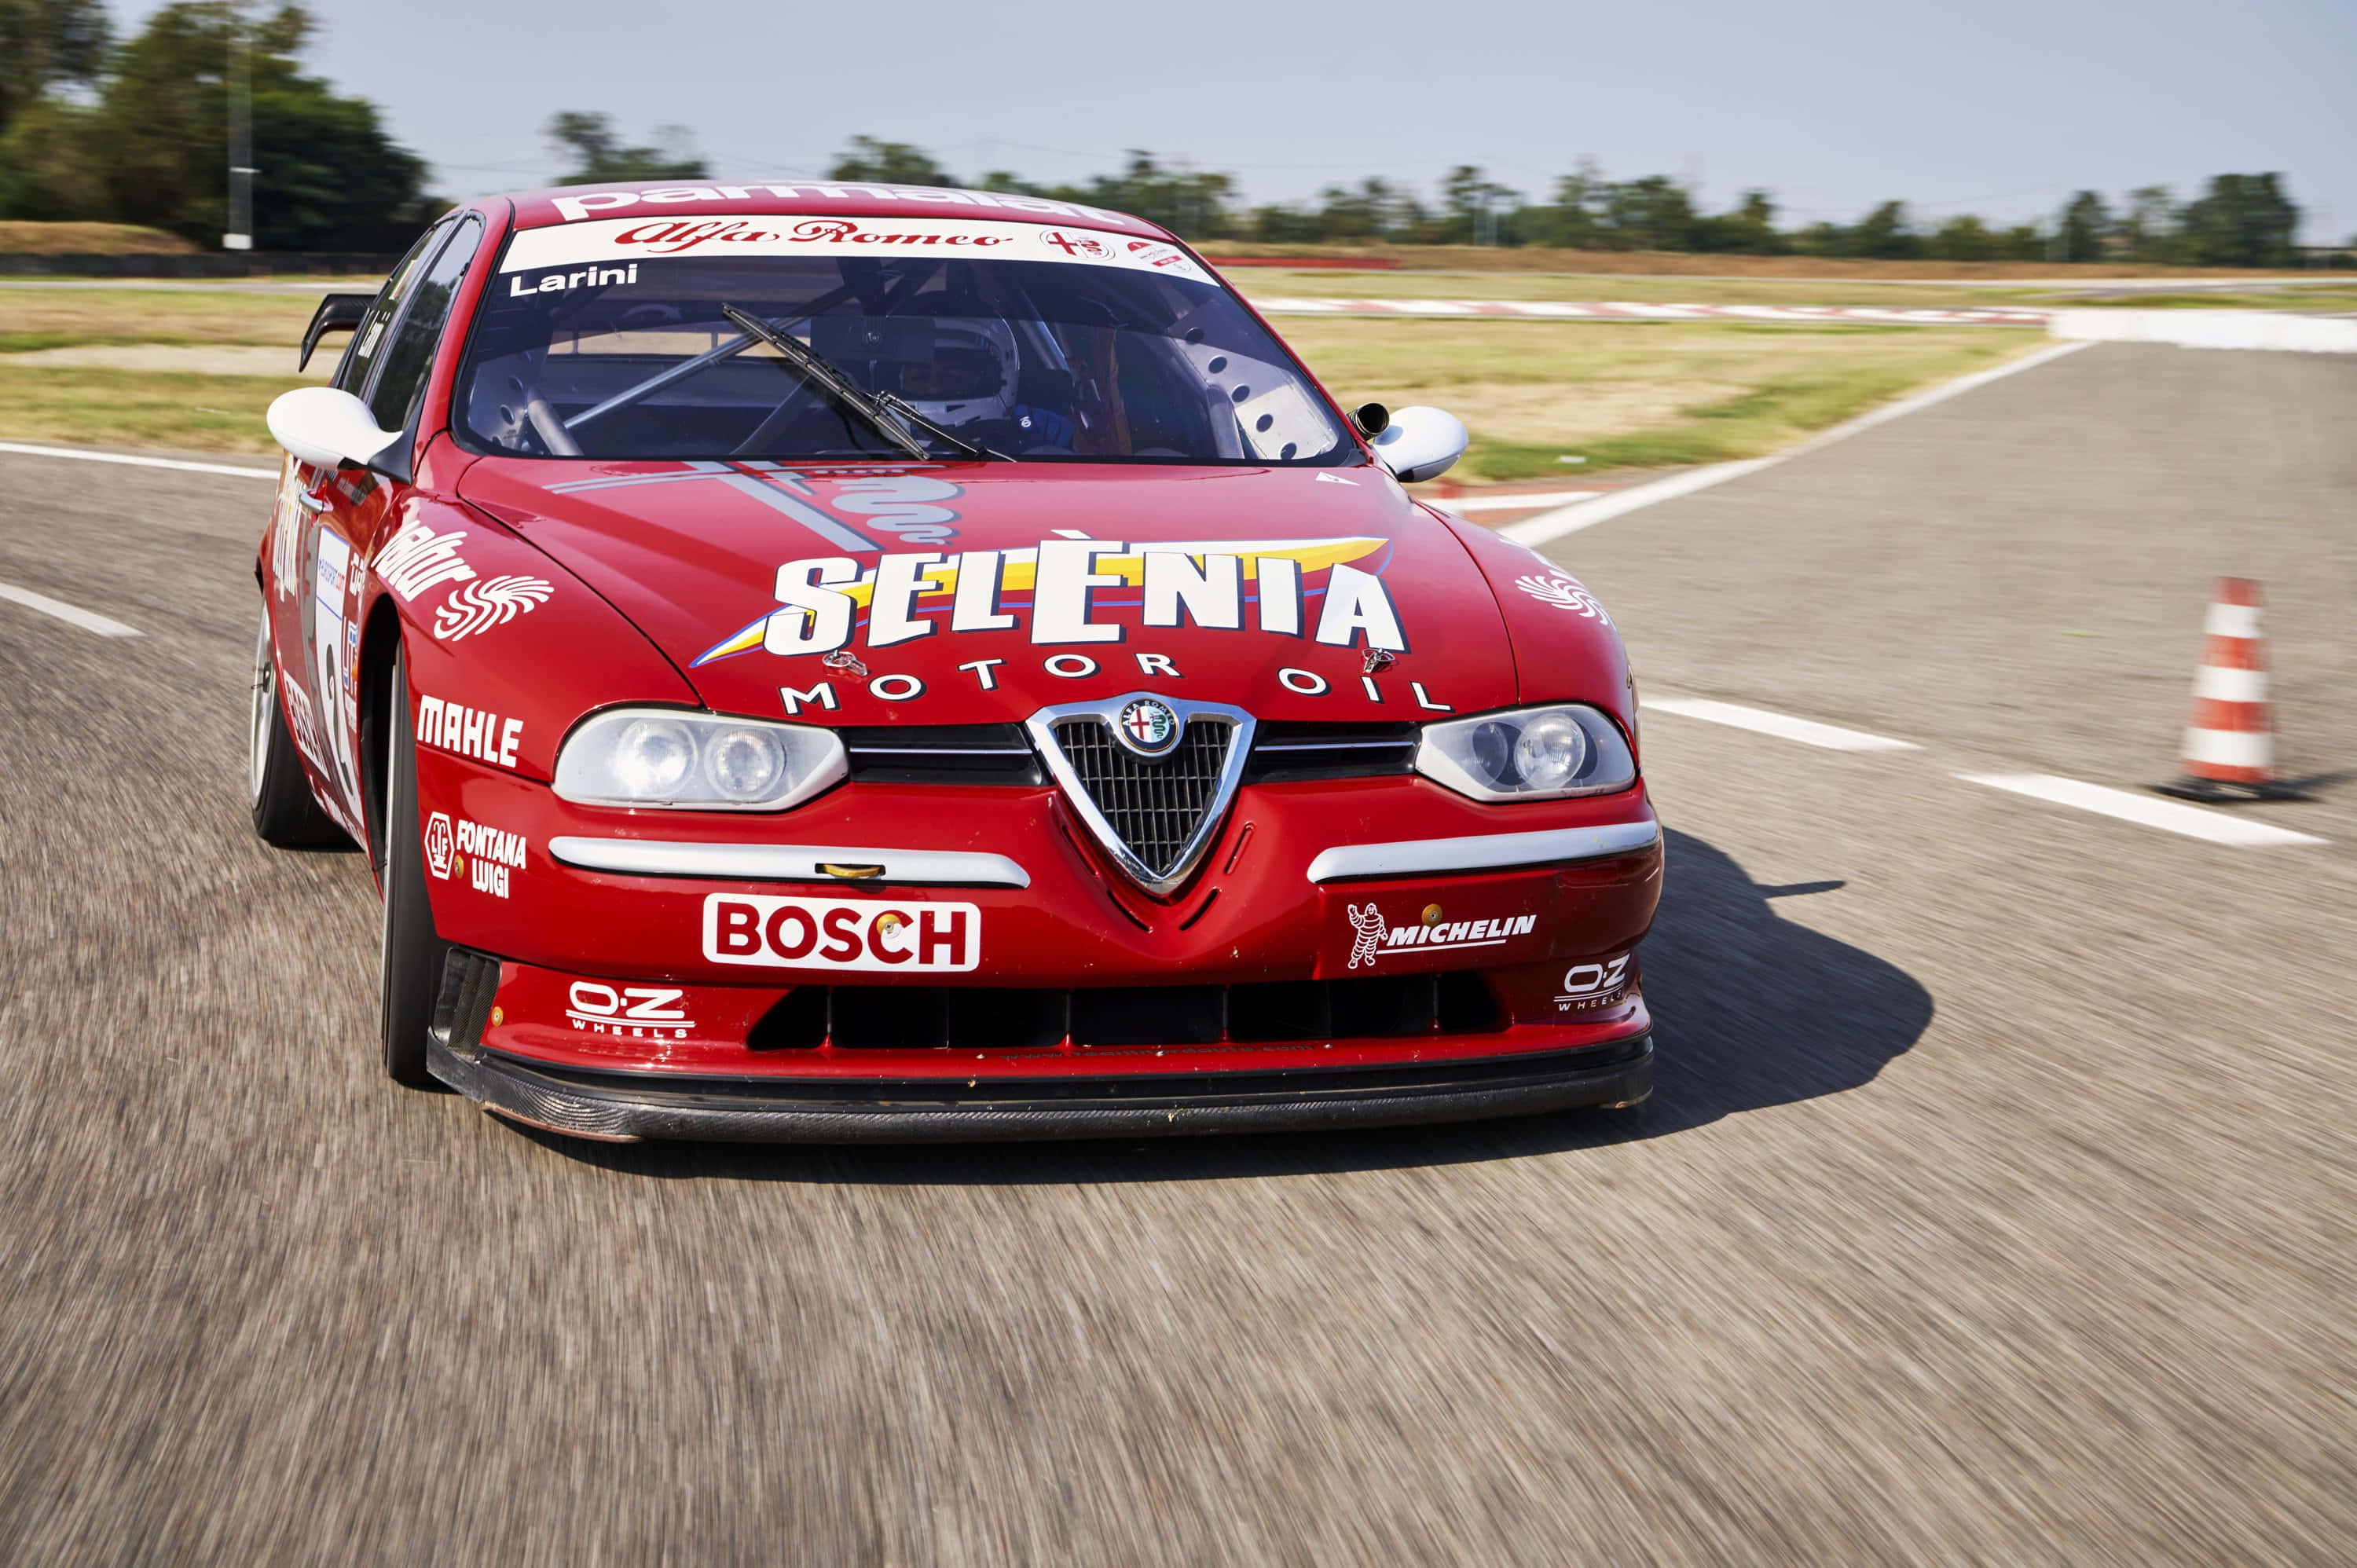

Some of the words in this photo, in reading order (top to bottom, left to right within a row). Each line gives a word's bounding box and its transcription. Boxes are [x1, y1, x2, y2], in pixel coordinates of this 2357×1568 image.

[614, 220, 780, 253] Alfa
[787, 220, 1014, 246] Romeo
[510, 263, 637, 296] Larini
[779, 651, 1184, 717] MOTOR
[1277, 664, 1455, 714] OIL
[417, 694, 524, 768] MAHLE
[456, 819, 527, 870] FONTANA
[471, 857, 510, 899] LUIGI
[716, 901, 967, 966] BOSCH
[1386, 914, 1538, 946] MICHELIN
[1557, 990, 1622, 1012] WHEELS
[571, 1019, 688, 1039] WHEELS
